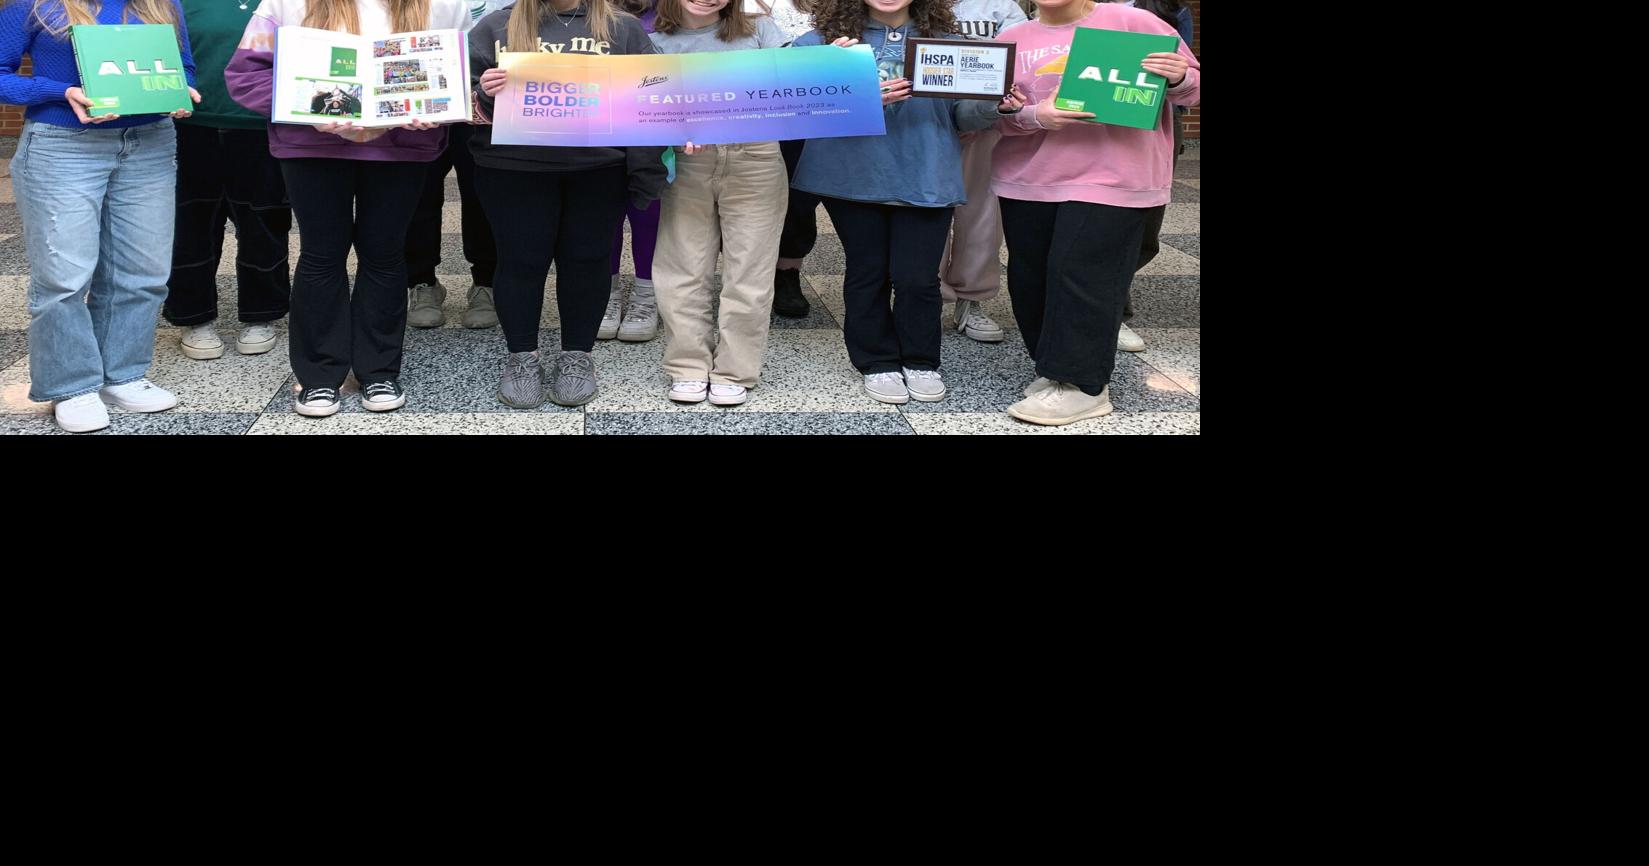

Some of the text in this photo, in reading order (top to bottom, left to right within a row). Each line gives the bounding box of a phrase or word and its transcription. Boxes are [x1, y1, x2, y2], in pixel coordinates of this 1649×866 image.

[570, 36, 611, 55] me
[920, 53, 954, 65] IHSPA
[98, 59, 178, 75] ALL
[142, 75, 184, 91] IN
[922, 74, 953, 87] WINNER
[1078, 65, 1159, 89] ALL
[525, 81, 600, 95] BIGGER
[637, 85, 852, 105] FEATURED YEARBOOK
[1113, 85, 1157, 106] IN
[523, 95, 599, 107] BOLDER
[653, 109, 684, 118] yearbook
[692, 106, 731, 116] showcased
[648, 117, 677, 125] example
